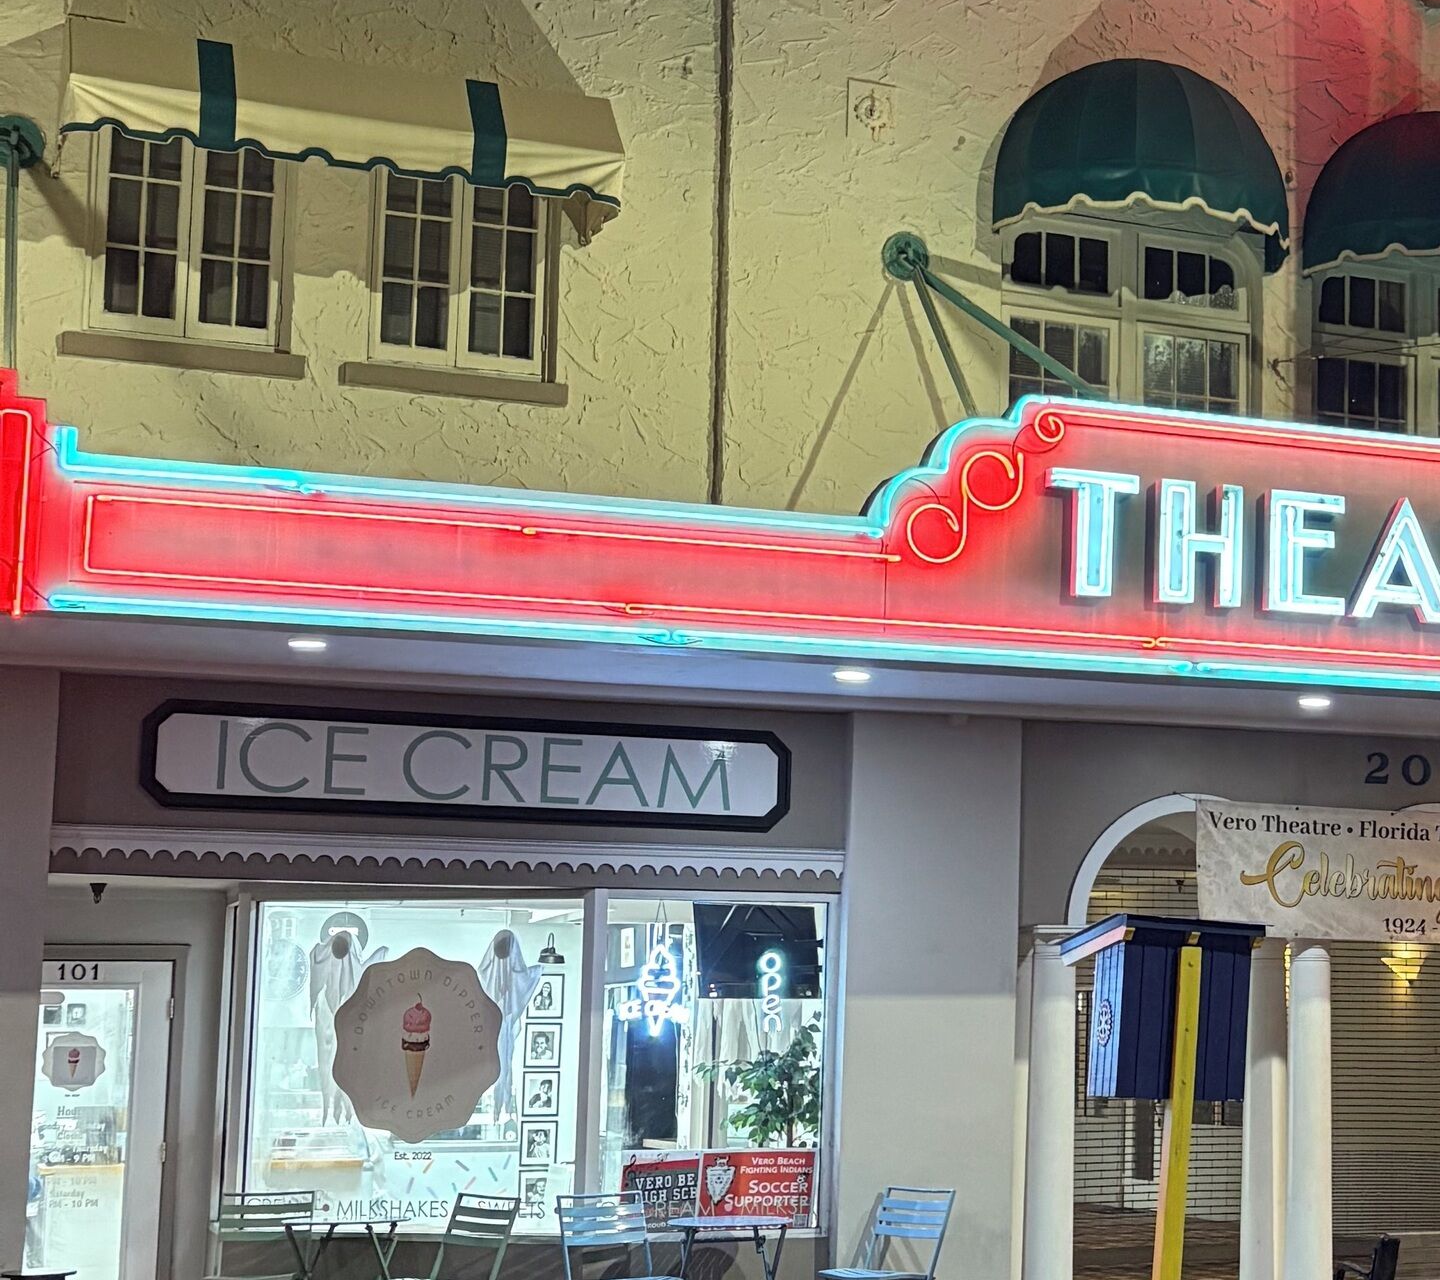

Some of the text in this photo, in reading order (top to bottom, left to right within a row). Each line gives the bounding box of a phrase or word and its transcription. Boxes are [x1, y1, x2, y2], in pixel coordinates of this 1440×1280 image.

[216, 720, 731, 812] ICE CREAM
[1207, 811, 1258, 831] Vero
[1261, 814, 1342, 837] Theatre
[1359, 820, 1430, 842] Florida
[1383, 916, 1427, 935] 1924
[58, 963, 100, 981] 101
[354, 969, 484, 1036] DOWNTOWN DIPPER
[406, 1094, 455, 1119] CREAM
[394, 1151, 432, 1160] Est. 2022
[635, 1175, 672, 1190] VERO
[748, 1180, 808, 1194] SOCCER
[336, 1200, 449, 1220] MILKSHAKES
[724, 1194, 810, 1207] SUPPORTER
